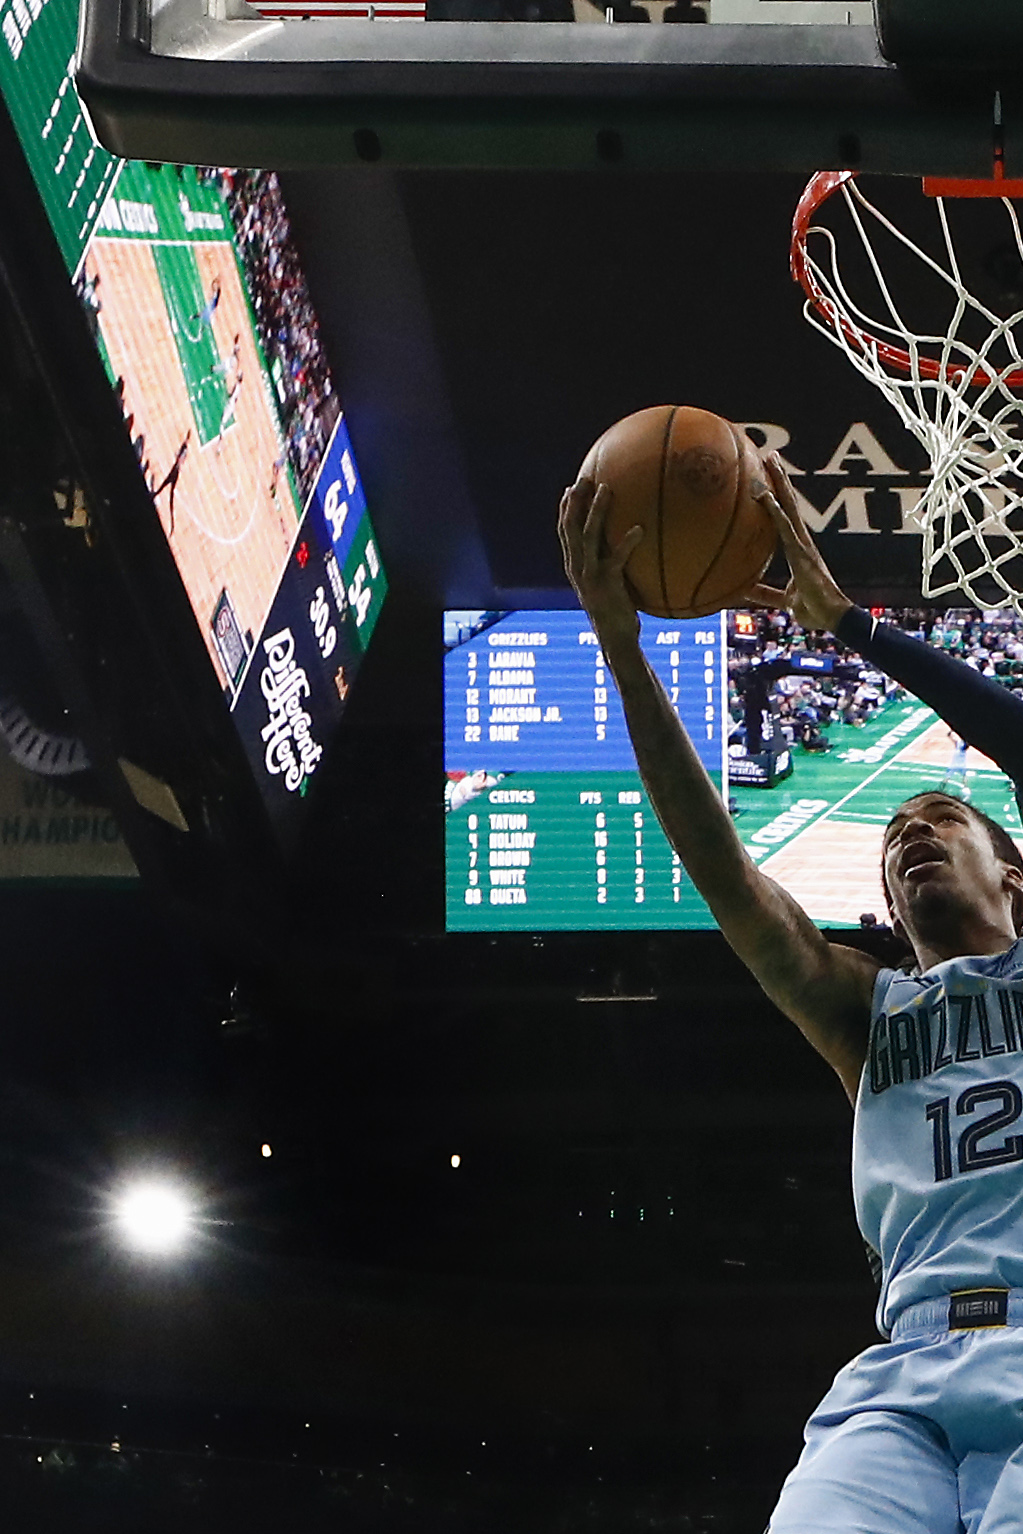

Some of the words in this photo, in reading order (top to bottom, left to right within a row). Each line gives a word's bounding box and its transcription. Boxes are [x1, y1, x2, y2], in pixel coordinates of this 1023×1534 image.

[348, 563, 374, 628] 54
[488, 632, 548, 646] GRIZZLIES
[656, 632, 680, 644] AST
[694, 632, 715, 644] FLS
[467, 652, 477, 668] 3
[488, 652, 536, 668] LARAVIA
[467, 670, 477, 686] 7
[671, 668, 678, 685] 1
[466, 688, 479, 705] 12
[488, 688, 536, 705] MORANT
[594, 687, 607, 704] 13
[670, 687, 680, 703] 7
[706, 687, 713, 703] 1
[466, 706, 479, 723] 13
[488, 706, 541, 723] JACKSON
[705, 705, 715, 721] 2
[464, 725, 481, 742] 22
[706, 723, 713, 740] 1
[489, 790, 535, 804] CELTICS
[579, 791, 602, 804] PTS
[617, 791, 641, 804] REB
[489, 814, 528, 830] TATUM
[633, 812, 643, 828] 5
[489, 832, 536, 849] HOLIDAY
[635, 830, 642, 847] 1
[468, 850, 477, 867] 7
[489, 850, 530, 867] BROWN
[635, 849, 642, 865] 1
[468, 869, 478, 885] 9
[489, 869, 526, 885] WHITE
[634, 867, 645, 884] 3
[671, 867, 681, 884] 3
[596, 886, 607, 903] 2
[634, 886, 645, 903] 3
[673, 886, 680, 903] 1
